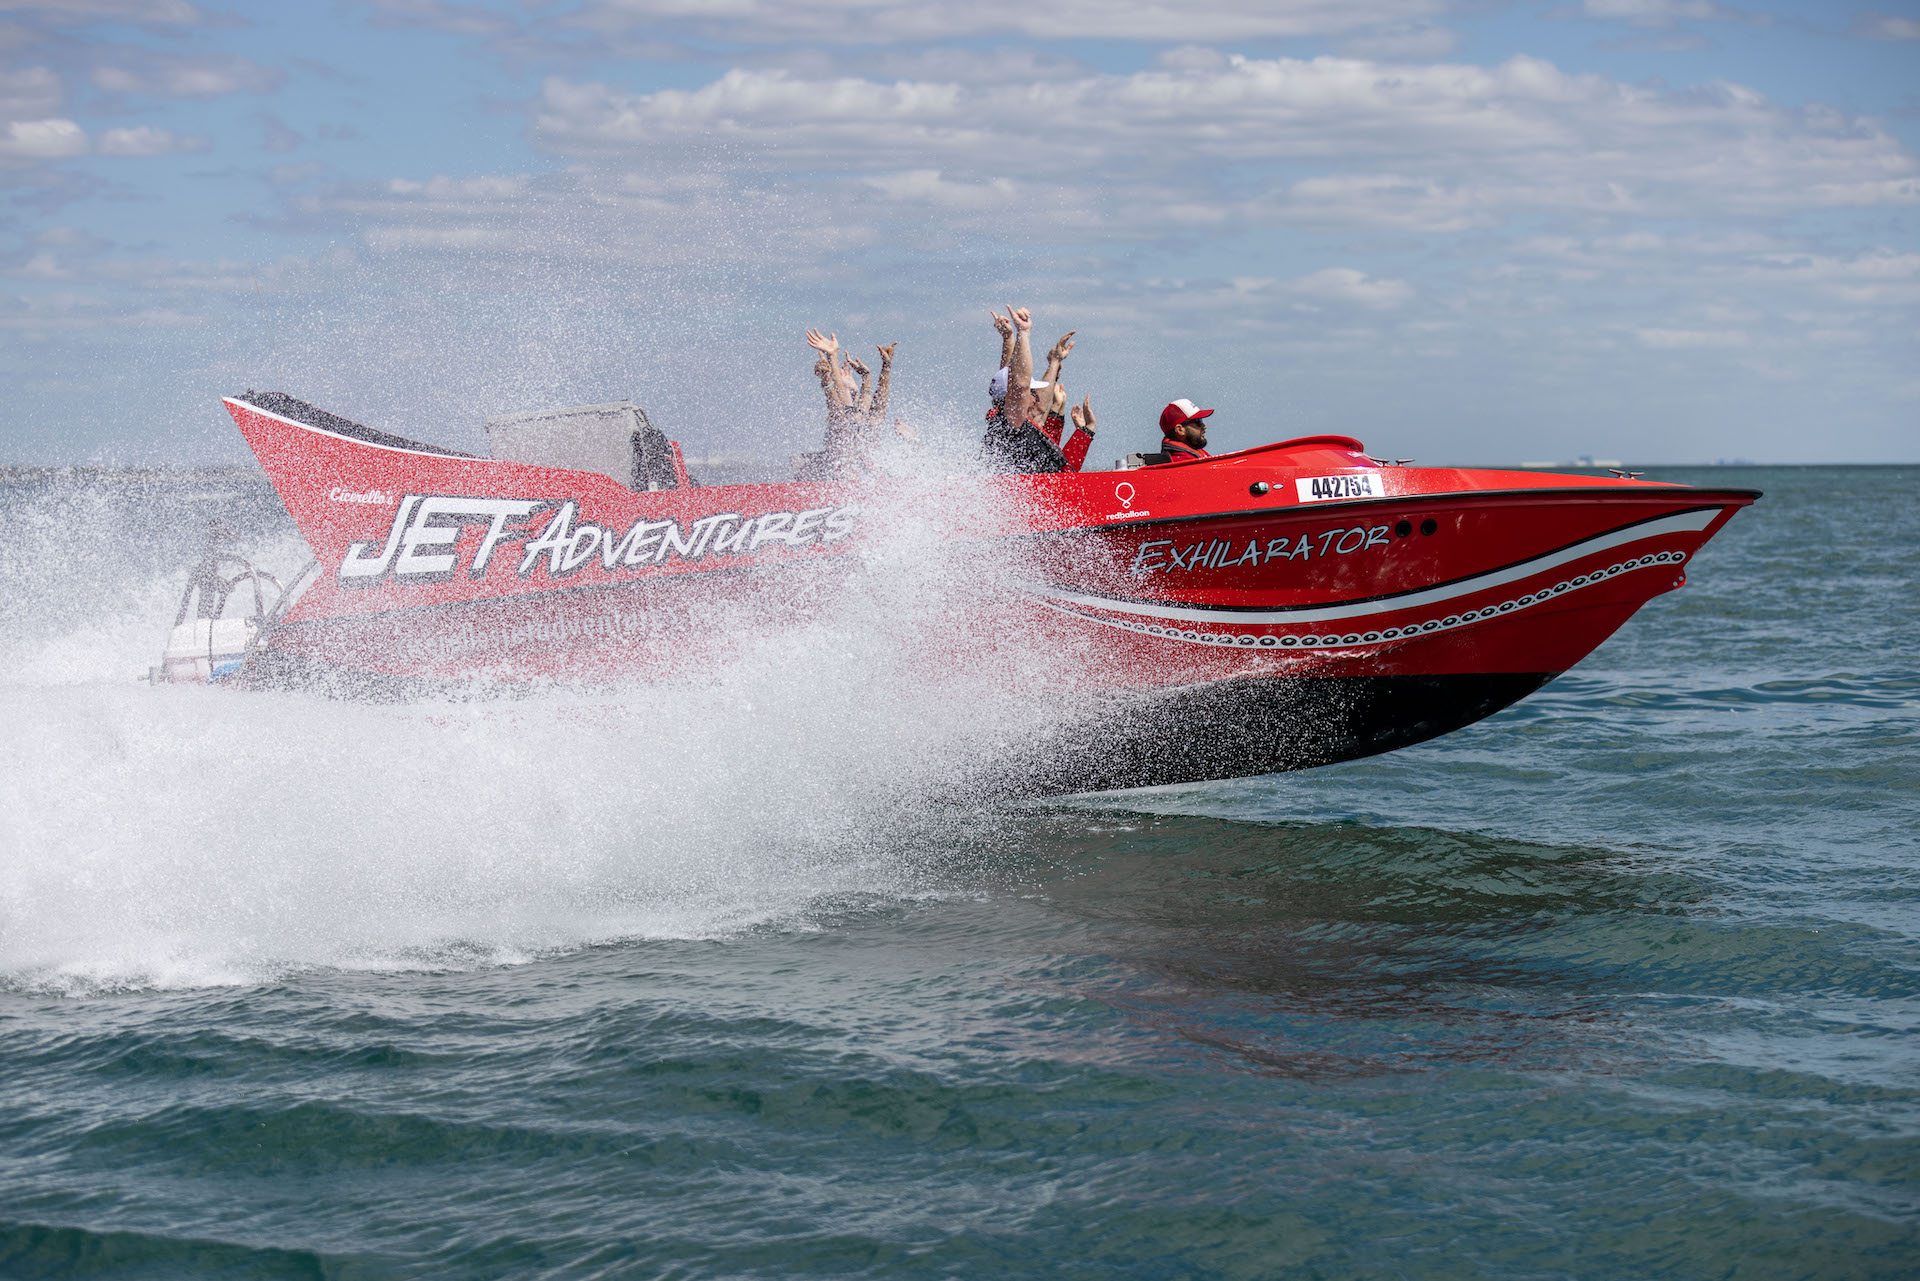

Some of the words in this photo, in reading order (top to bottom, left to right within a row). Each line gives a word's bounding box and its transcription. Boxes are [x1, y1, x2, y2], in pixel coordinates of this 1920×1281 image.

[329, 486, 394, 505] Cicerello's
[1311, 475, 1372, 499] 442754
[1105, 510, 1151, 521] redballoon
[339, 494, 546, 579] JET
[517, 500, 860, 573] ADVENTURES
[1129, 524, 1392, 576] EXHILARATOR
